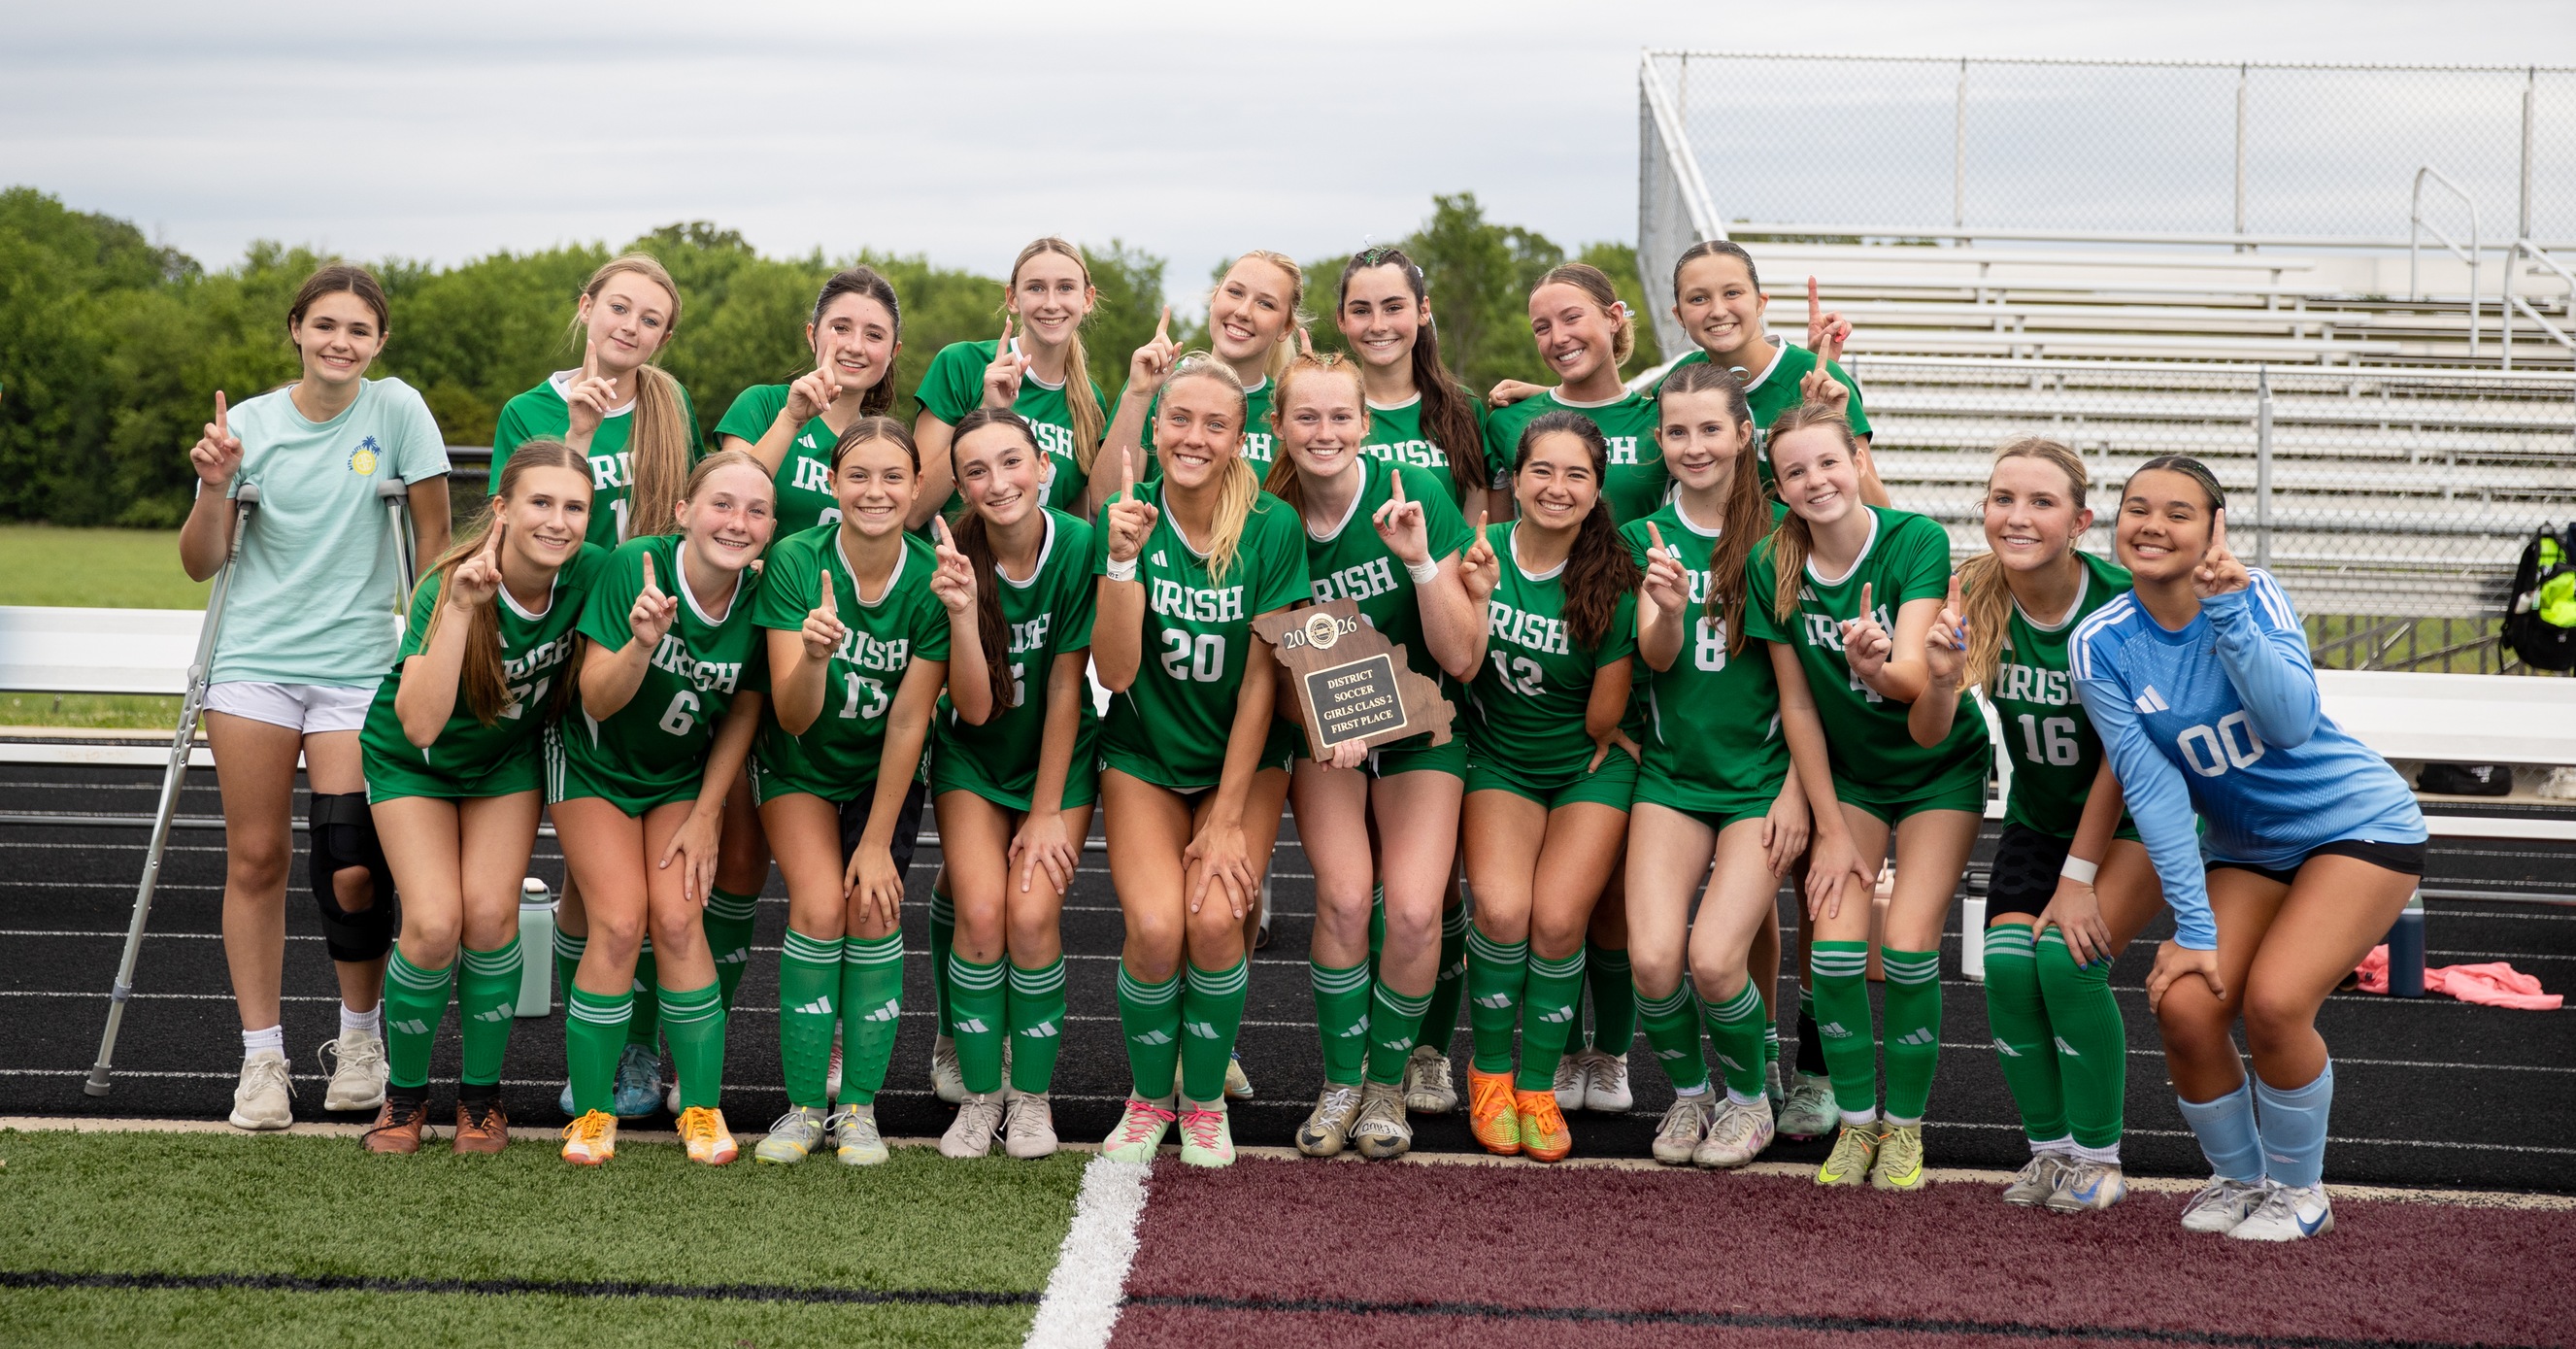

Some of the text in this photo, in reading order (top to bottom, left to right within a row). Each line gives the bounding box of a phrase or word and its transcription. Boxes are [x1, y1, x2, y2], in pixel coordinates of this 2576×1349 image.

[1019, 415, 1074, 460] ISH
[1359, 440, 1450, 468] RISH
[1150, 576, 1244, 623] IRISH
[1310, 556, 1398, 604] RISH
[831, 626, 909, 672] RISH
[1284, 629, 1305, 650] 20
[1336, 615, 1357, 636] 26
[1489, 599, 1570, 656] RISH
[1694, 616, 1726, 672] 8
[1802, 603, 1895, 652] IRH
[501, 625, 576, 684] RISH
[651, 633, 742, 694] IRISH
[1160, 627, 1225, 682] 20
[1490, 649, 1547, 696] 12
[838, 671, 888, 720] 13
[1326, 669, 1373, 690] DISTRICT
[1334, 684, 1375, 703] SOCCER
[658, 689, 701, 737] 6
[1323, 694, 1393, 721] GIRLS CLASS 2
[1330, 709, 1394, 734] FIRST PLACE
[2018, 713, 2080, 766] 16
[2176, 709, 2265, 778] 00
